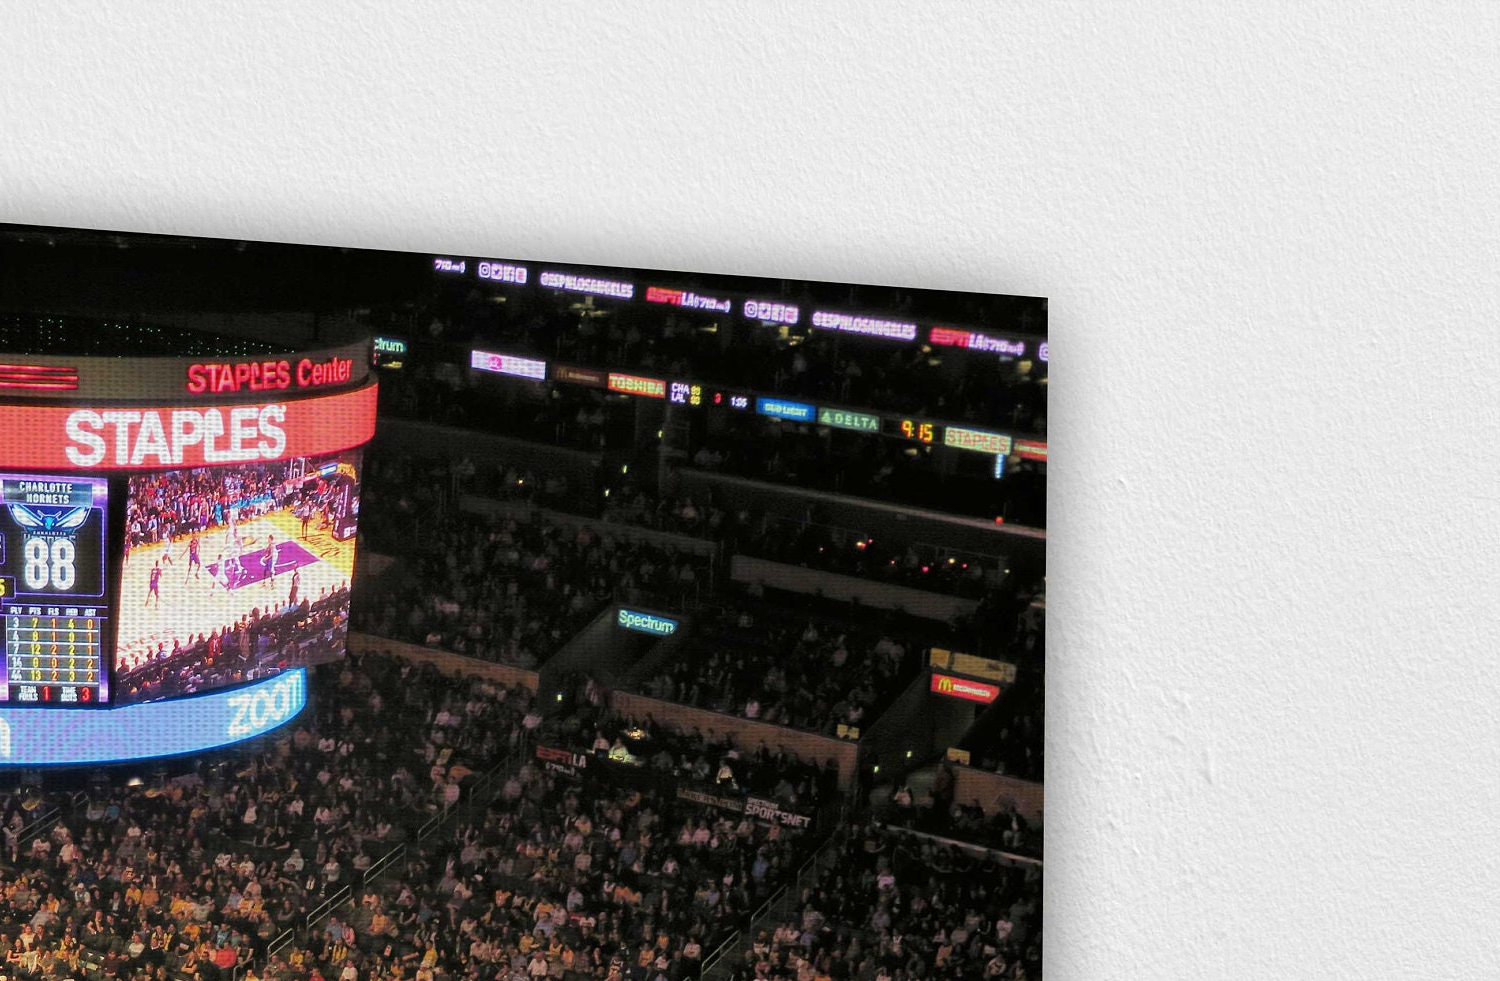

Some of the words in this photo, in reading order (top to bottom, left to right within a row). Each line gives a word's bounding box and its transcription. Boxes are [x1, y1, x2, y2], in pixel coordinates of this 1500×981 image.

[187, 360, 291, 395] STAPLES
[297, 356, 354, 388] Center
[609, 375, 665, 396] TOSHIBA
[671, 382, 690, 395] CHA
[670, 392, 686, 403] LAL
[834, 412, 878, 431] DELTA
[65, 404, 288, 467] STAPLES
[902, 420, 933, 443] 9:15
[947, 429, 1009, 453] STAPLES
[19, 482, 73, 494] CHARLOTTE
[26, 493, 70, 504] HORNETS
[24, 537, 76, 590] 88
[48, 608, 60, 616] FLS
[32, 617, 39, 628] 7
[51, 618, 57, 628] 1
[68, 619, 75, 629] 4
[87, 619, 94, 629] 0
[619, 609, 675, 633] Spectrum
[51, 632, 57, 641] 1
[87, 632, 93, 642] 1
[31, 644, 41, 655] 12
[51, 645, 58, 655] 2
[69, 645, 75, 655] 2
[88, 646, 93, 655] 1
[69, 658, 75, 669] 2
[87, 659, 93, 669] 2
[31, 670, 41, 681] 13
[51, 671, 58, 681] 2
[69, 671, 75, 682] 3
[87, 672, 94, 682] 2
[44, 686, 51, 701] 1
[82, 687, 91, 701] 3
[745, 804, 811, 828] SPORTSNET
